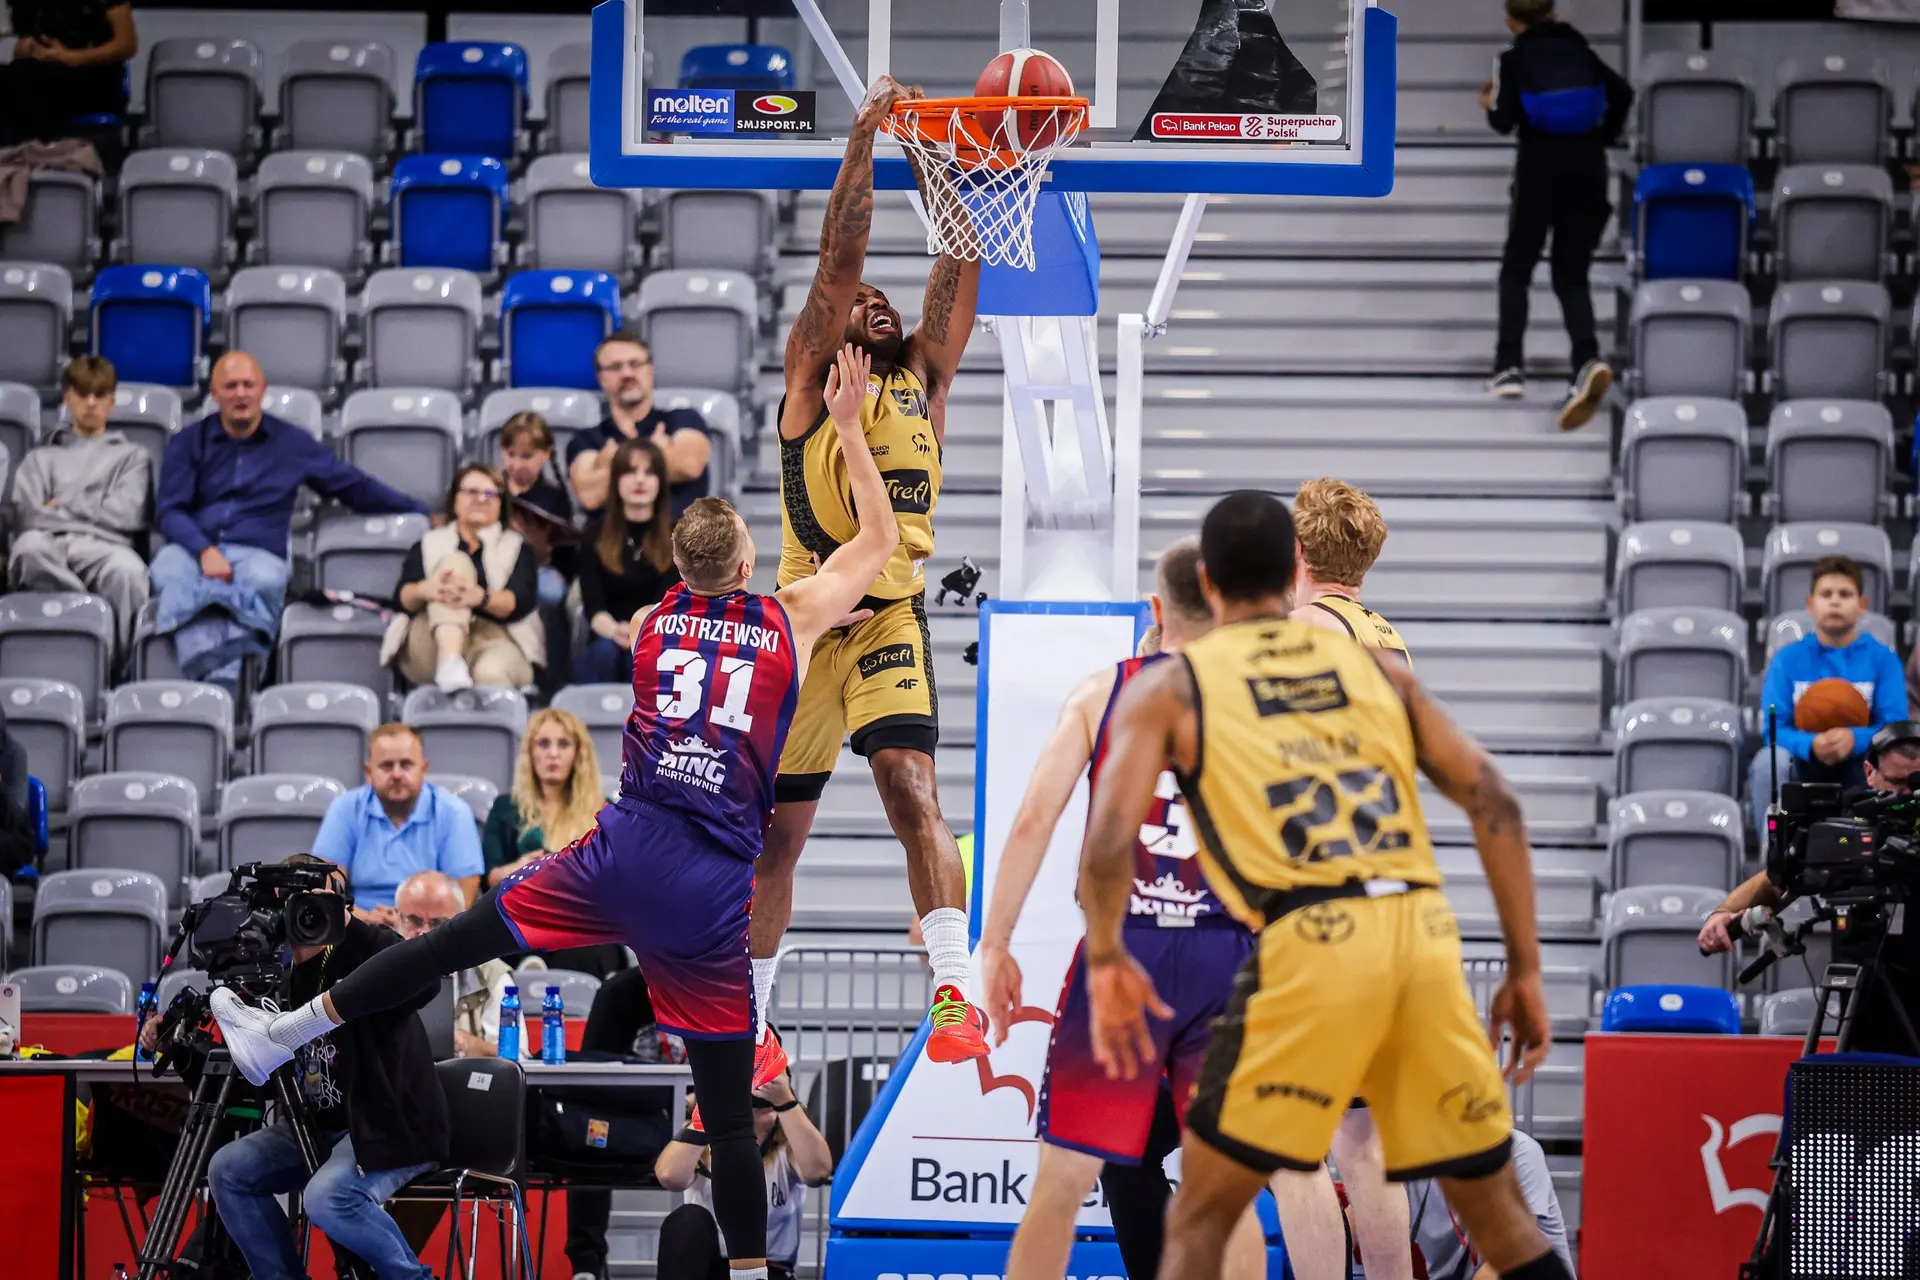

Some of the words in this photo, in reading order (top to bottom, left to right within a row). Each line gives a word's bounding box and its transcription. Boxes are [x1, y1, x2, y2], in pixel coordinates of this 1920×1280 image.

[653, 94, 729, 114] molten
[651, 115, 666, 125] For
[668, 115, 682, 124] the
[682, 115, 702, 125] real
[702, 117, 729, 127] game
[736, 119, 813, 130] SMJSPORT.PL
[1183, 121, 1206, 132] Bank
[1208, 122, 1236, 132] Pekao
[1267, 116, 1337, 128] Superpuchar
[1266, 128, 1298, 138] Polski
[884, 480, 930, 504] Trefl
[653, 614, 780, 654] KOSTRZEWSKI
[877, 648, 911, 666] Trefl
[655, 648, 756, 733] 31
[894, 678, 919, 690] 4F
[657, 751, 727, 786] KING
[655, 766, 721, 795] HURTOWNIE
[1264, 767, 1412, 868] 22
[911, 1157, 1027, 1206] Bank
